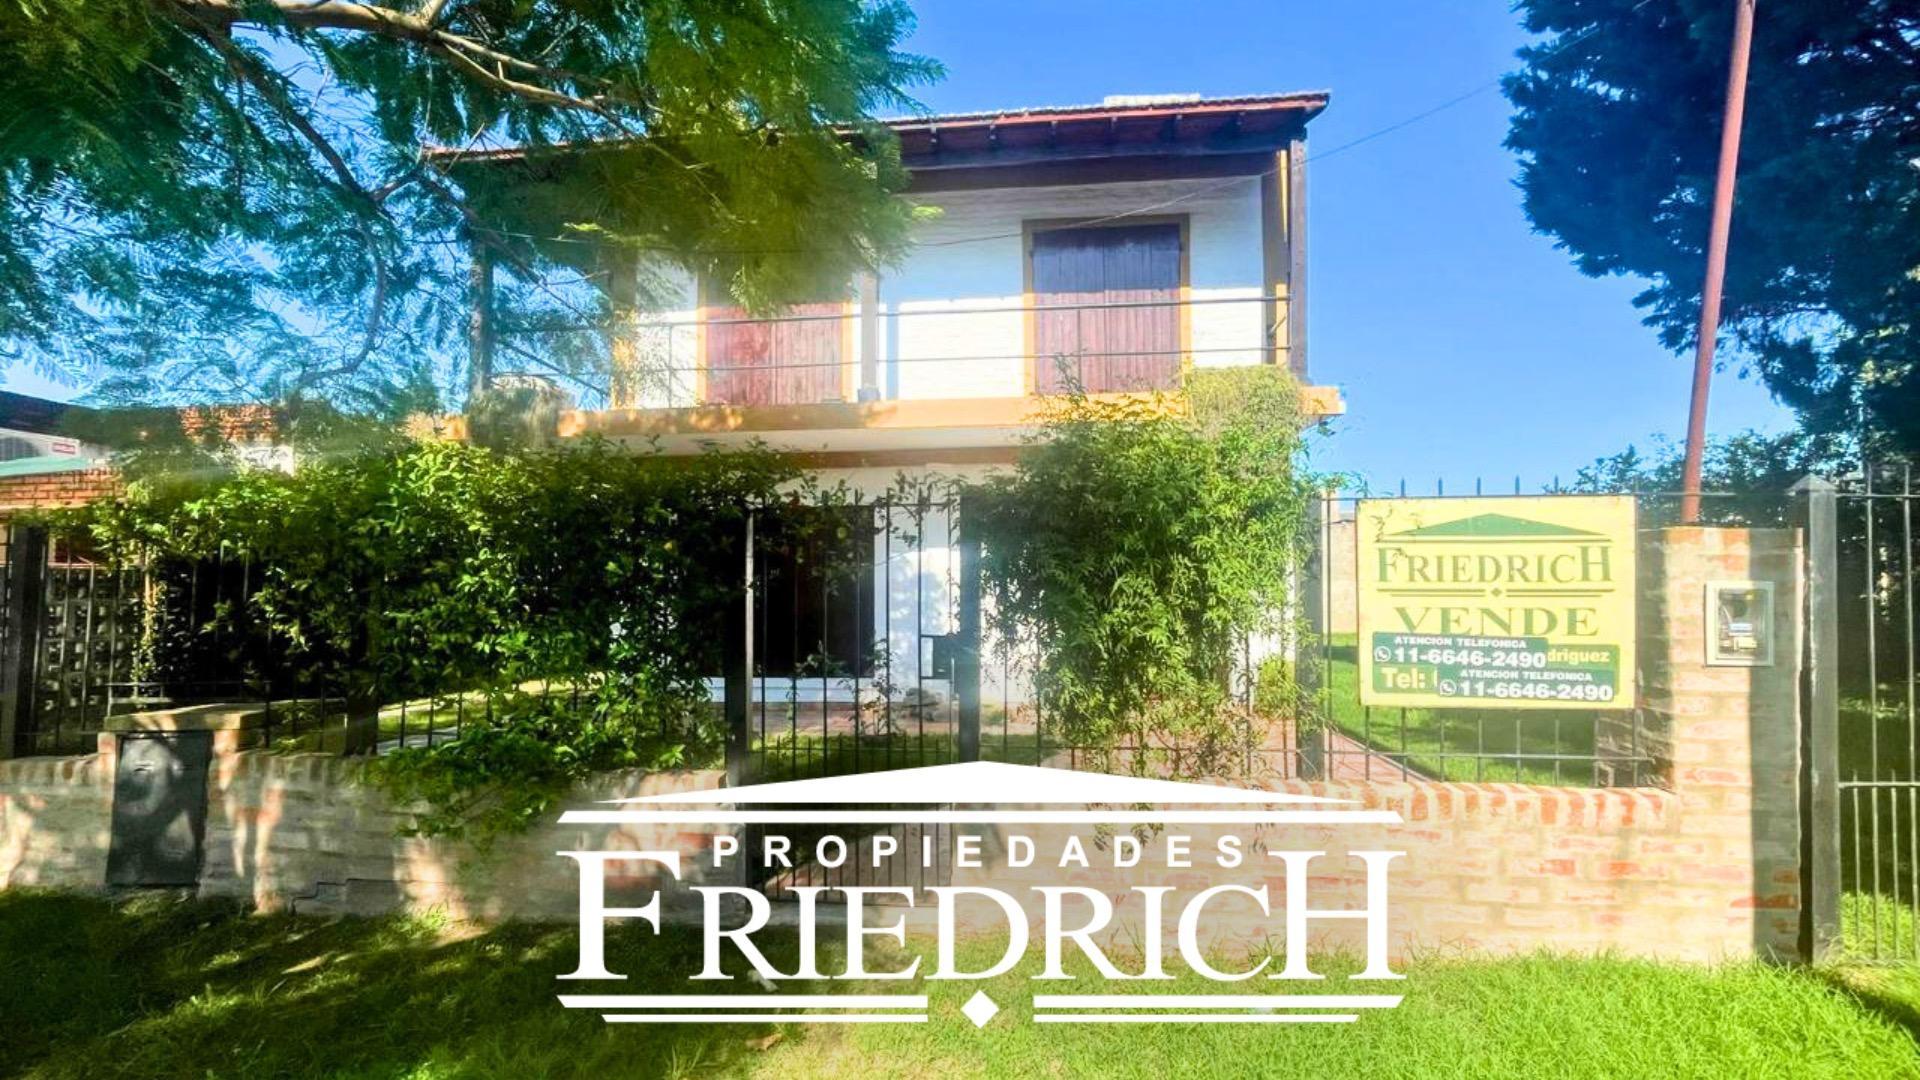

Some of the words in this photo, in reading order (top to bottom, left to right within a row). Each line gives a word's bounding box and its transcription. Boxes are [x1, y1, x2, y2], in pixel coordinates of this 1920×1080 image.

[1377, 545, 1613, 583] FRIEDRICH
[1394, 606, 1600, 637] VENDE
[1394, 636, 1453, 646] ATENCION
[1457, 638, 1527, 649] TELEFONICA
[1394, 647, 1546, 668] 11-6646-2490
[1381, 667, 1426, 689] Tel:
[1460, 669, 1519, 680] ATENCION
[1523, 671, 1593, 682] TELEFONICA
[1459, 680, 1613, 701] 11-6646-2490
